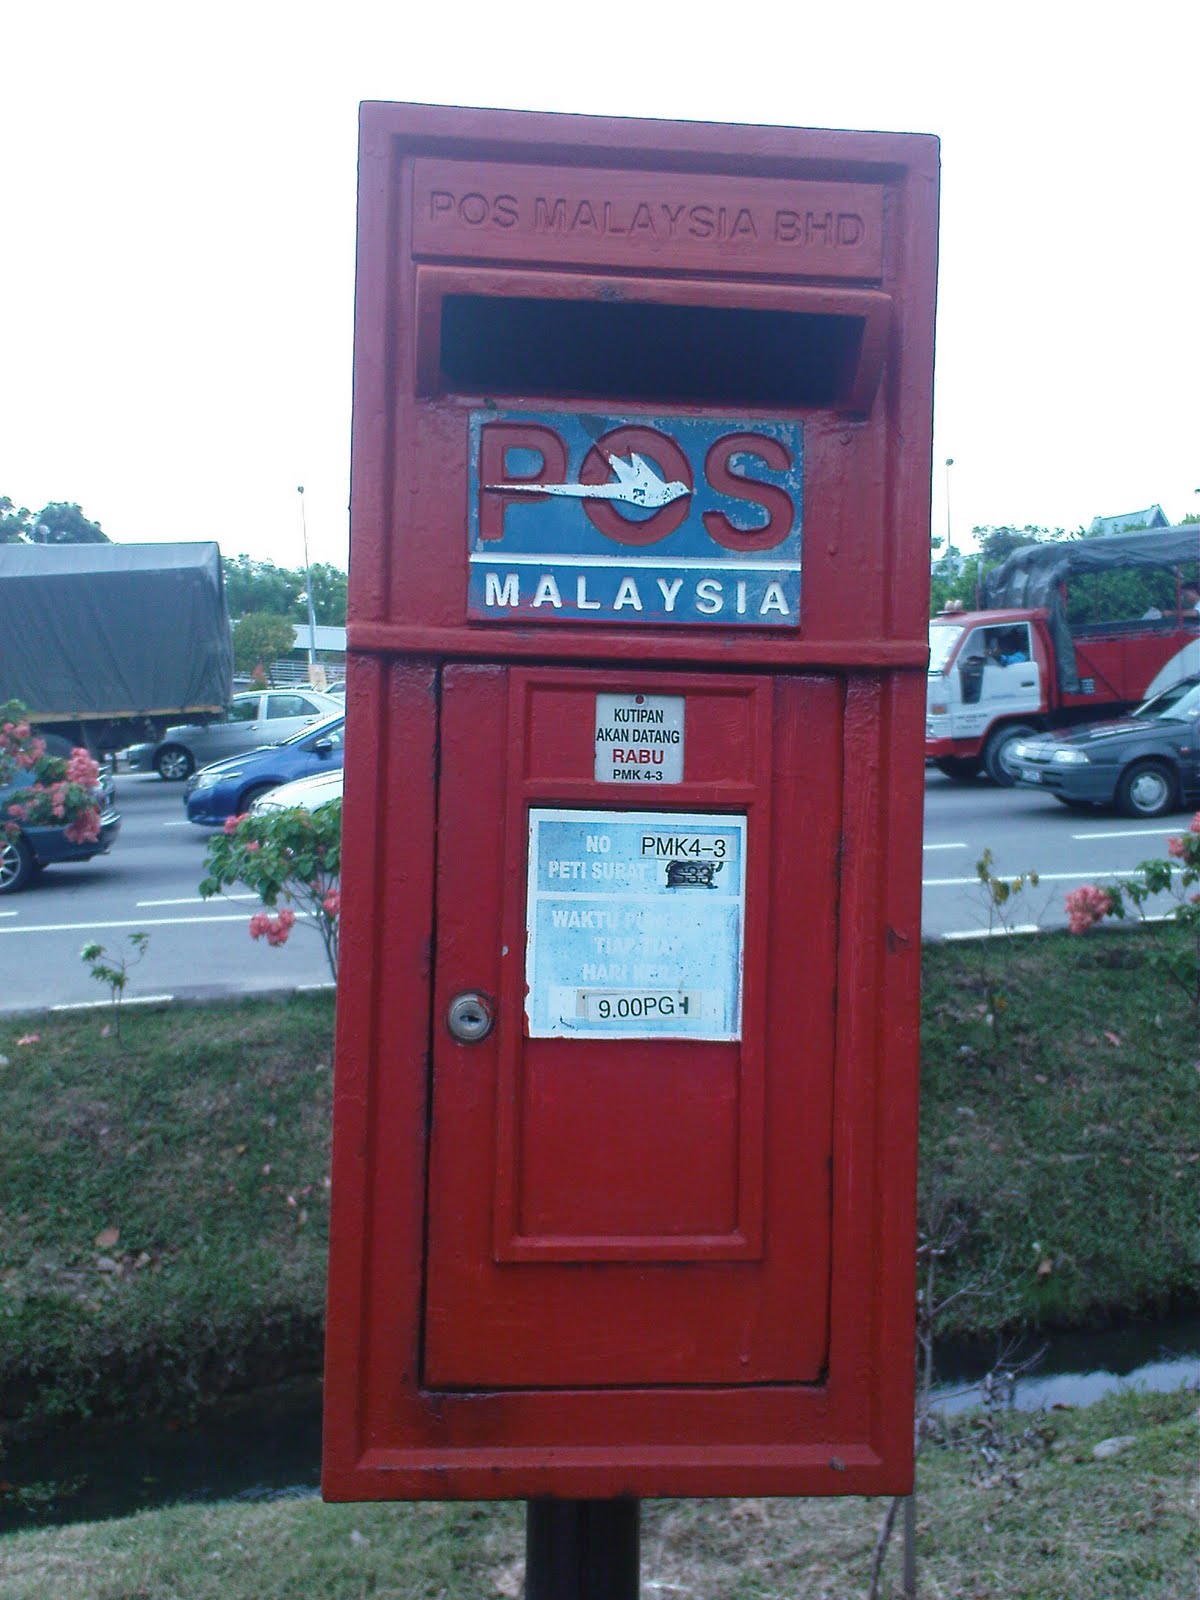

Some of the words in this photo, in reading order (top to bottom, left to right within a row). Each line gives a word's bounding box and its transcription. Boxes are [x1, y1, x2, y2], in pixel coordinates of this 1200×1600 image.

[430, 190, 519, 228] POS
[534, 196, 758, 240] MALAYSIA
[774, 209, 865, 247] BHD
[478, 420, 795, 552] POS
[485, 572, 790, 615] MALAYSIA
[614, 708, 664, 723] KUTIPAN
[597, 728, 629, 742] AKAN
[632, 729, 680, 743] DATANG
[613, 749, 664, 764] RABU
[613, 769, 641, 780] PMK
[644, 771, 663, 780] 4-3
[586, 835, 611, 853] NO
[641, 837, 726, 858] PMK4-3
[548, 860, 587, 879] PETI
[591, 861, 649, 881] SURAT
[552, 910, 619, 929] WAKTU
